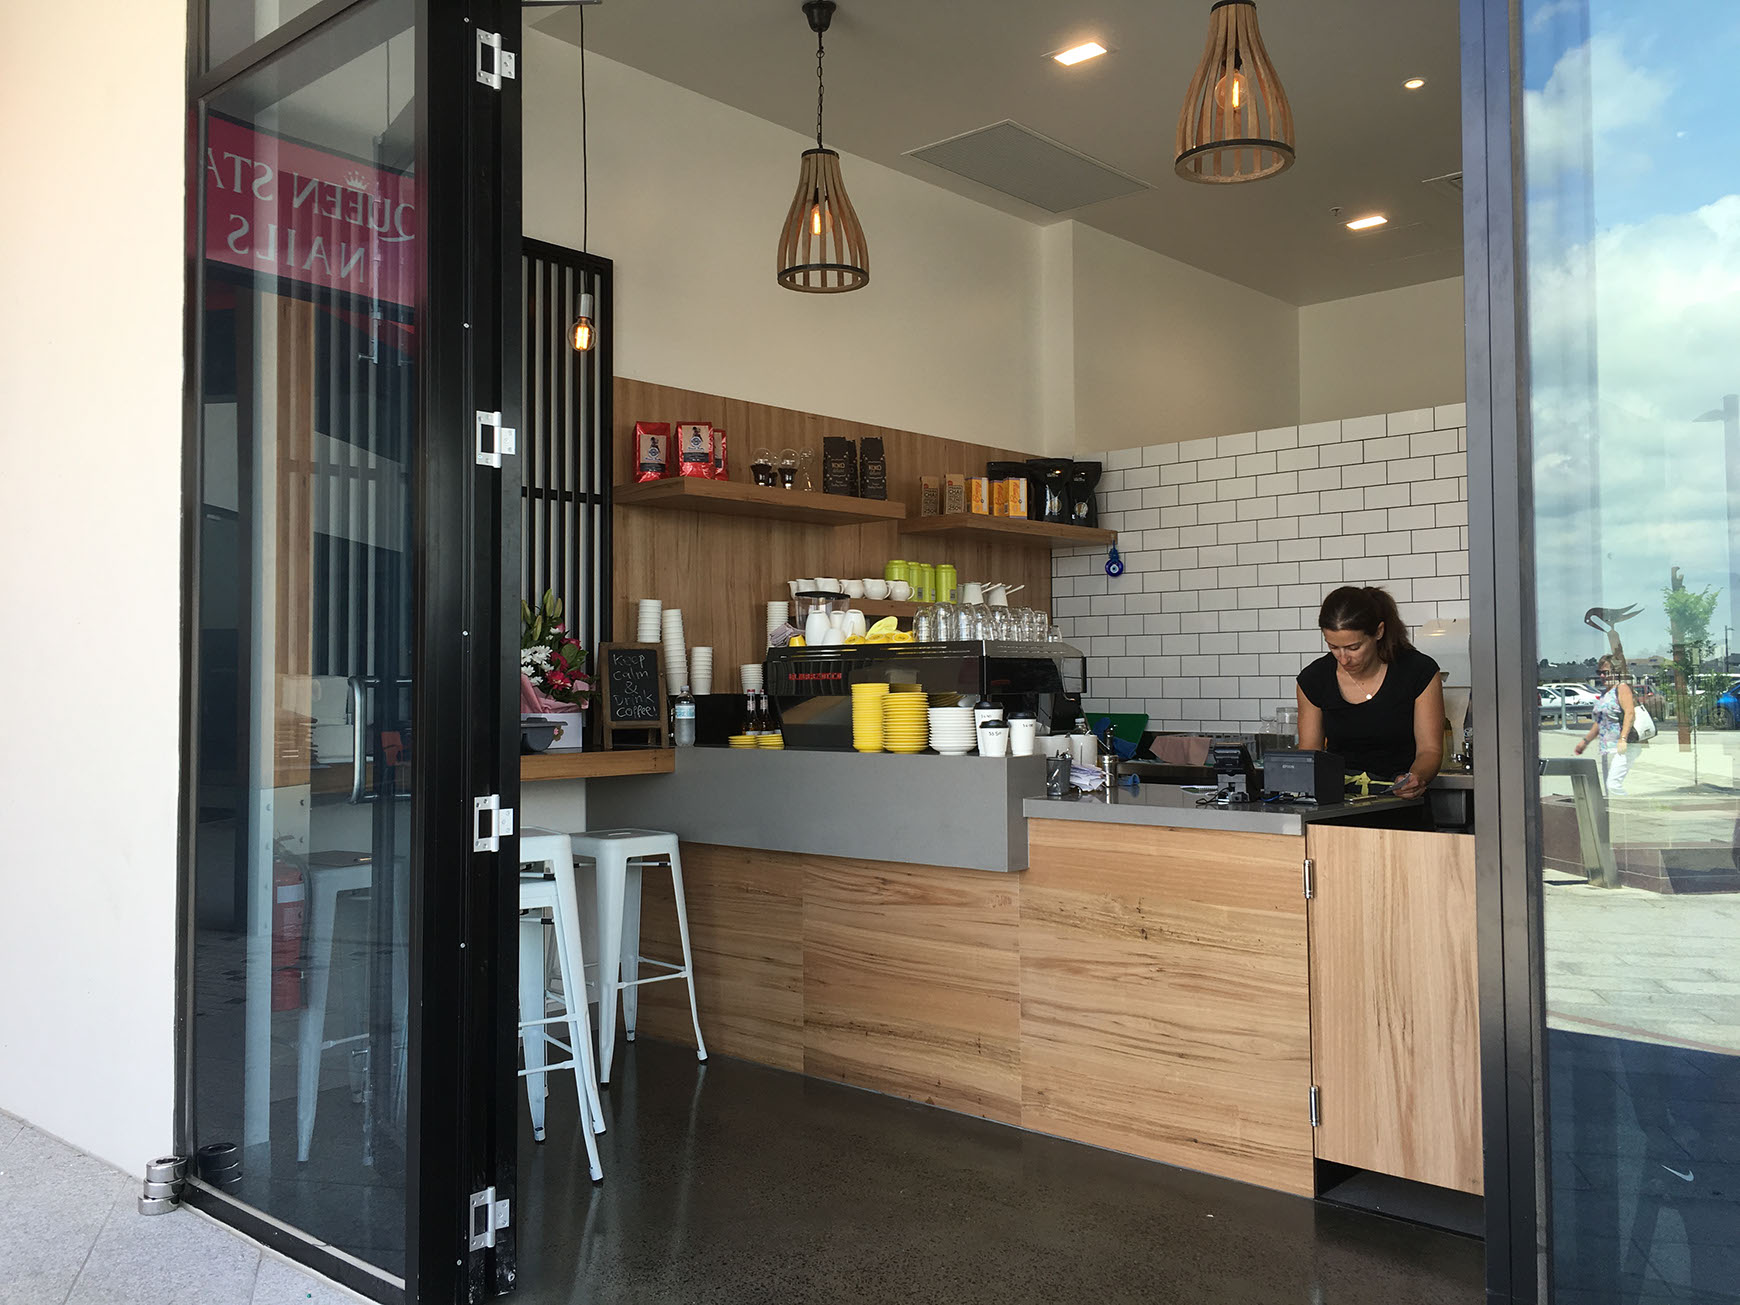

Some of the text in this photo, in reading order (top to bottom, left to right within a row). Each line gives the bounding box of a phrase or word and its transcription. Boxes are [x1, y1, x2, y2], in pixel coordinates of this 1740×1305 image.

[613, 654, 646, 669] Keep
[613, 667, 649, 681] Calm
[624, 680, 638, 695] &
[613, 689, 655, 706] Drink
